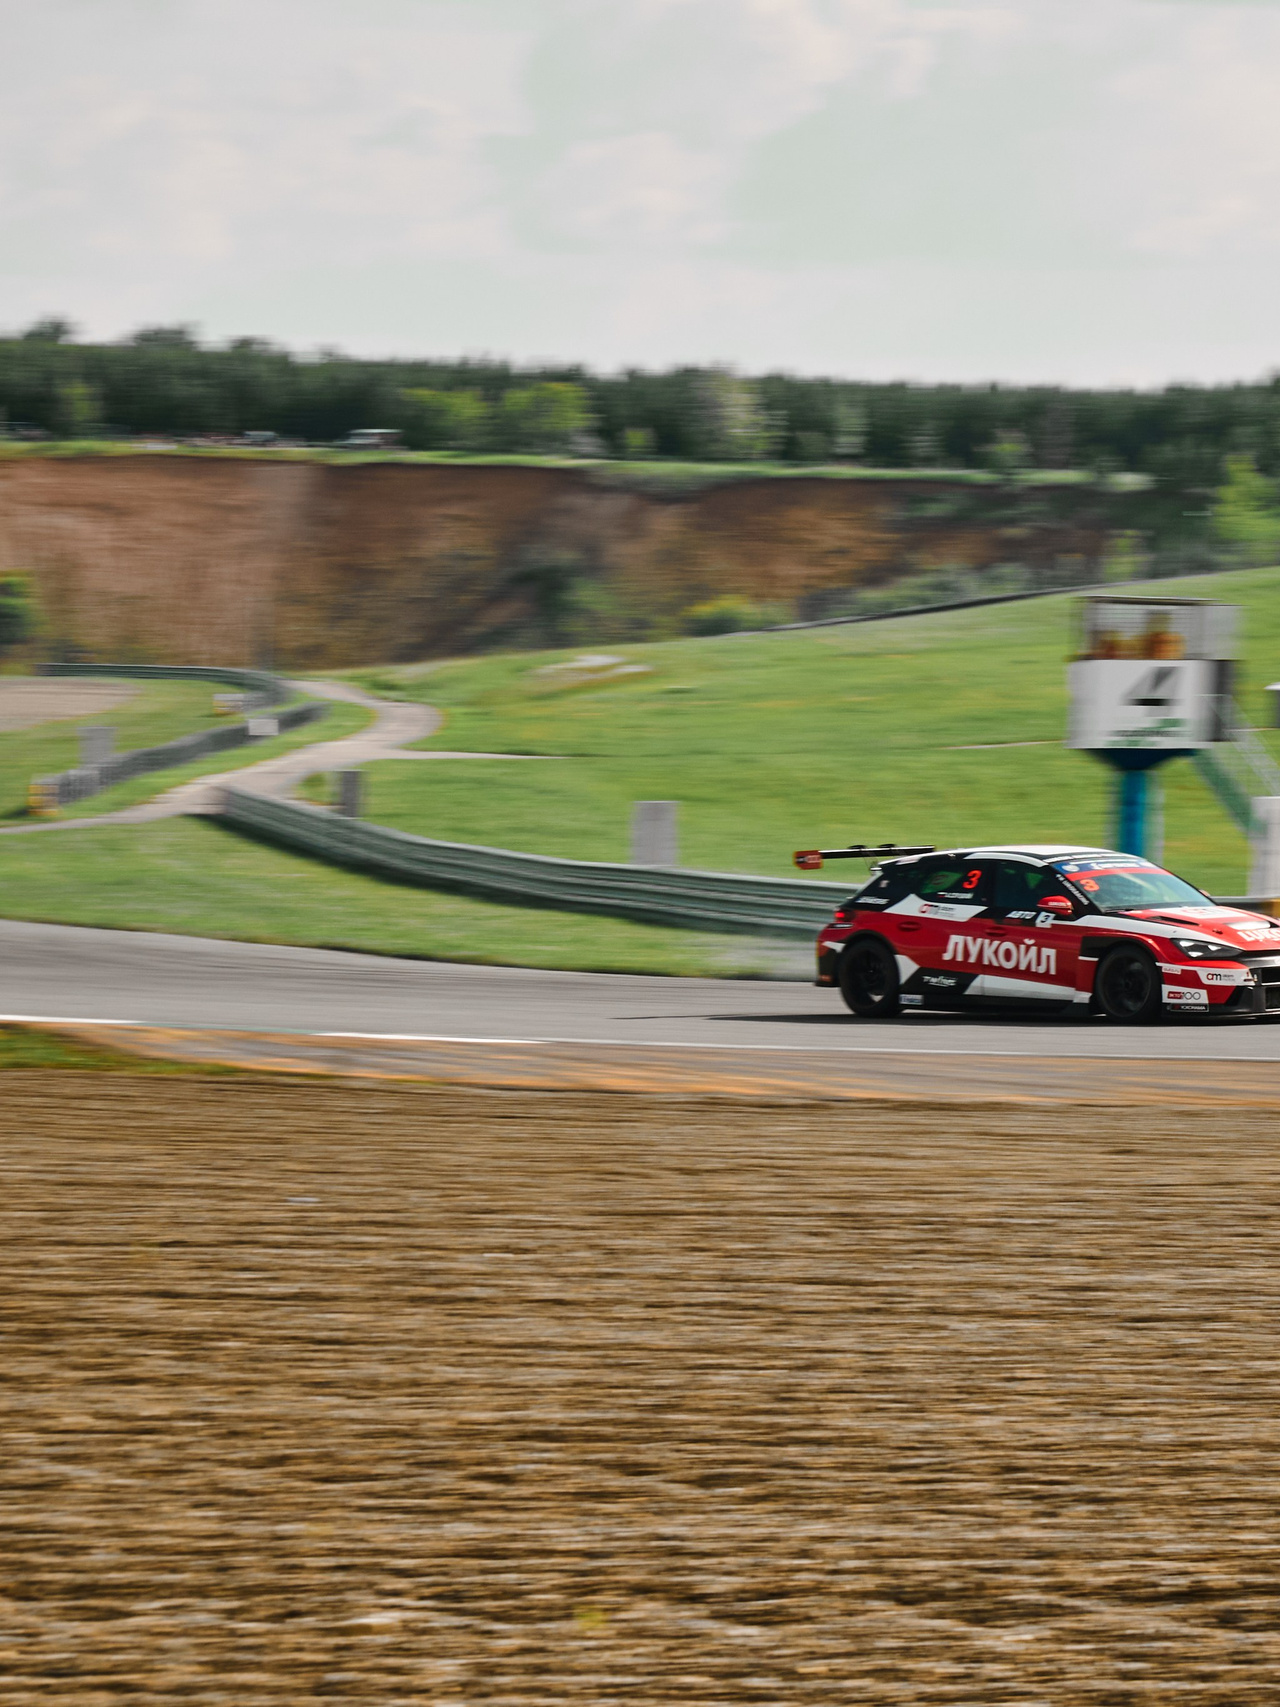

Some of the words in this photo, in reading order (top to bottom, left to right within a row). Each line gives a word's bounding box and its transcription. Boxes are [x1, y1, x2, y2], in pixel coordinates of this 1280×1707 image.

[1121, 666, 1182, 717] 4
[962, 870, 982, 889] 3
[1080, 879, 1100, 892] 3
[1039, 914, 1049, 924] 3
[942, 934, 1057, 975] ЛУКОЙЛ
